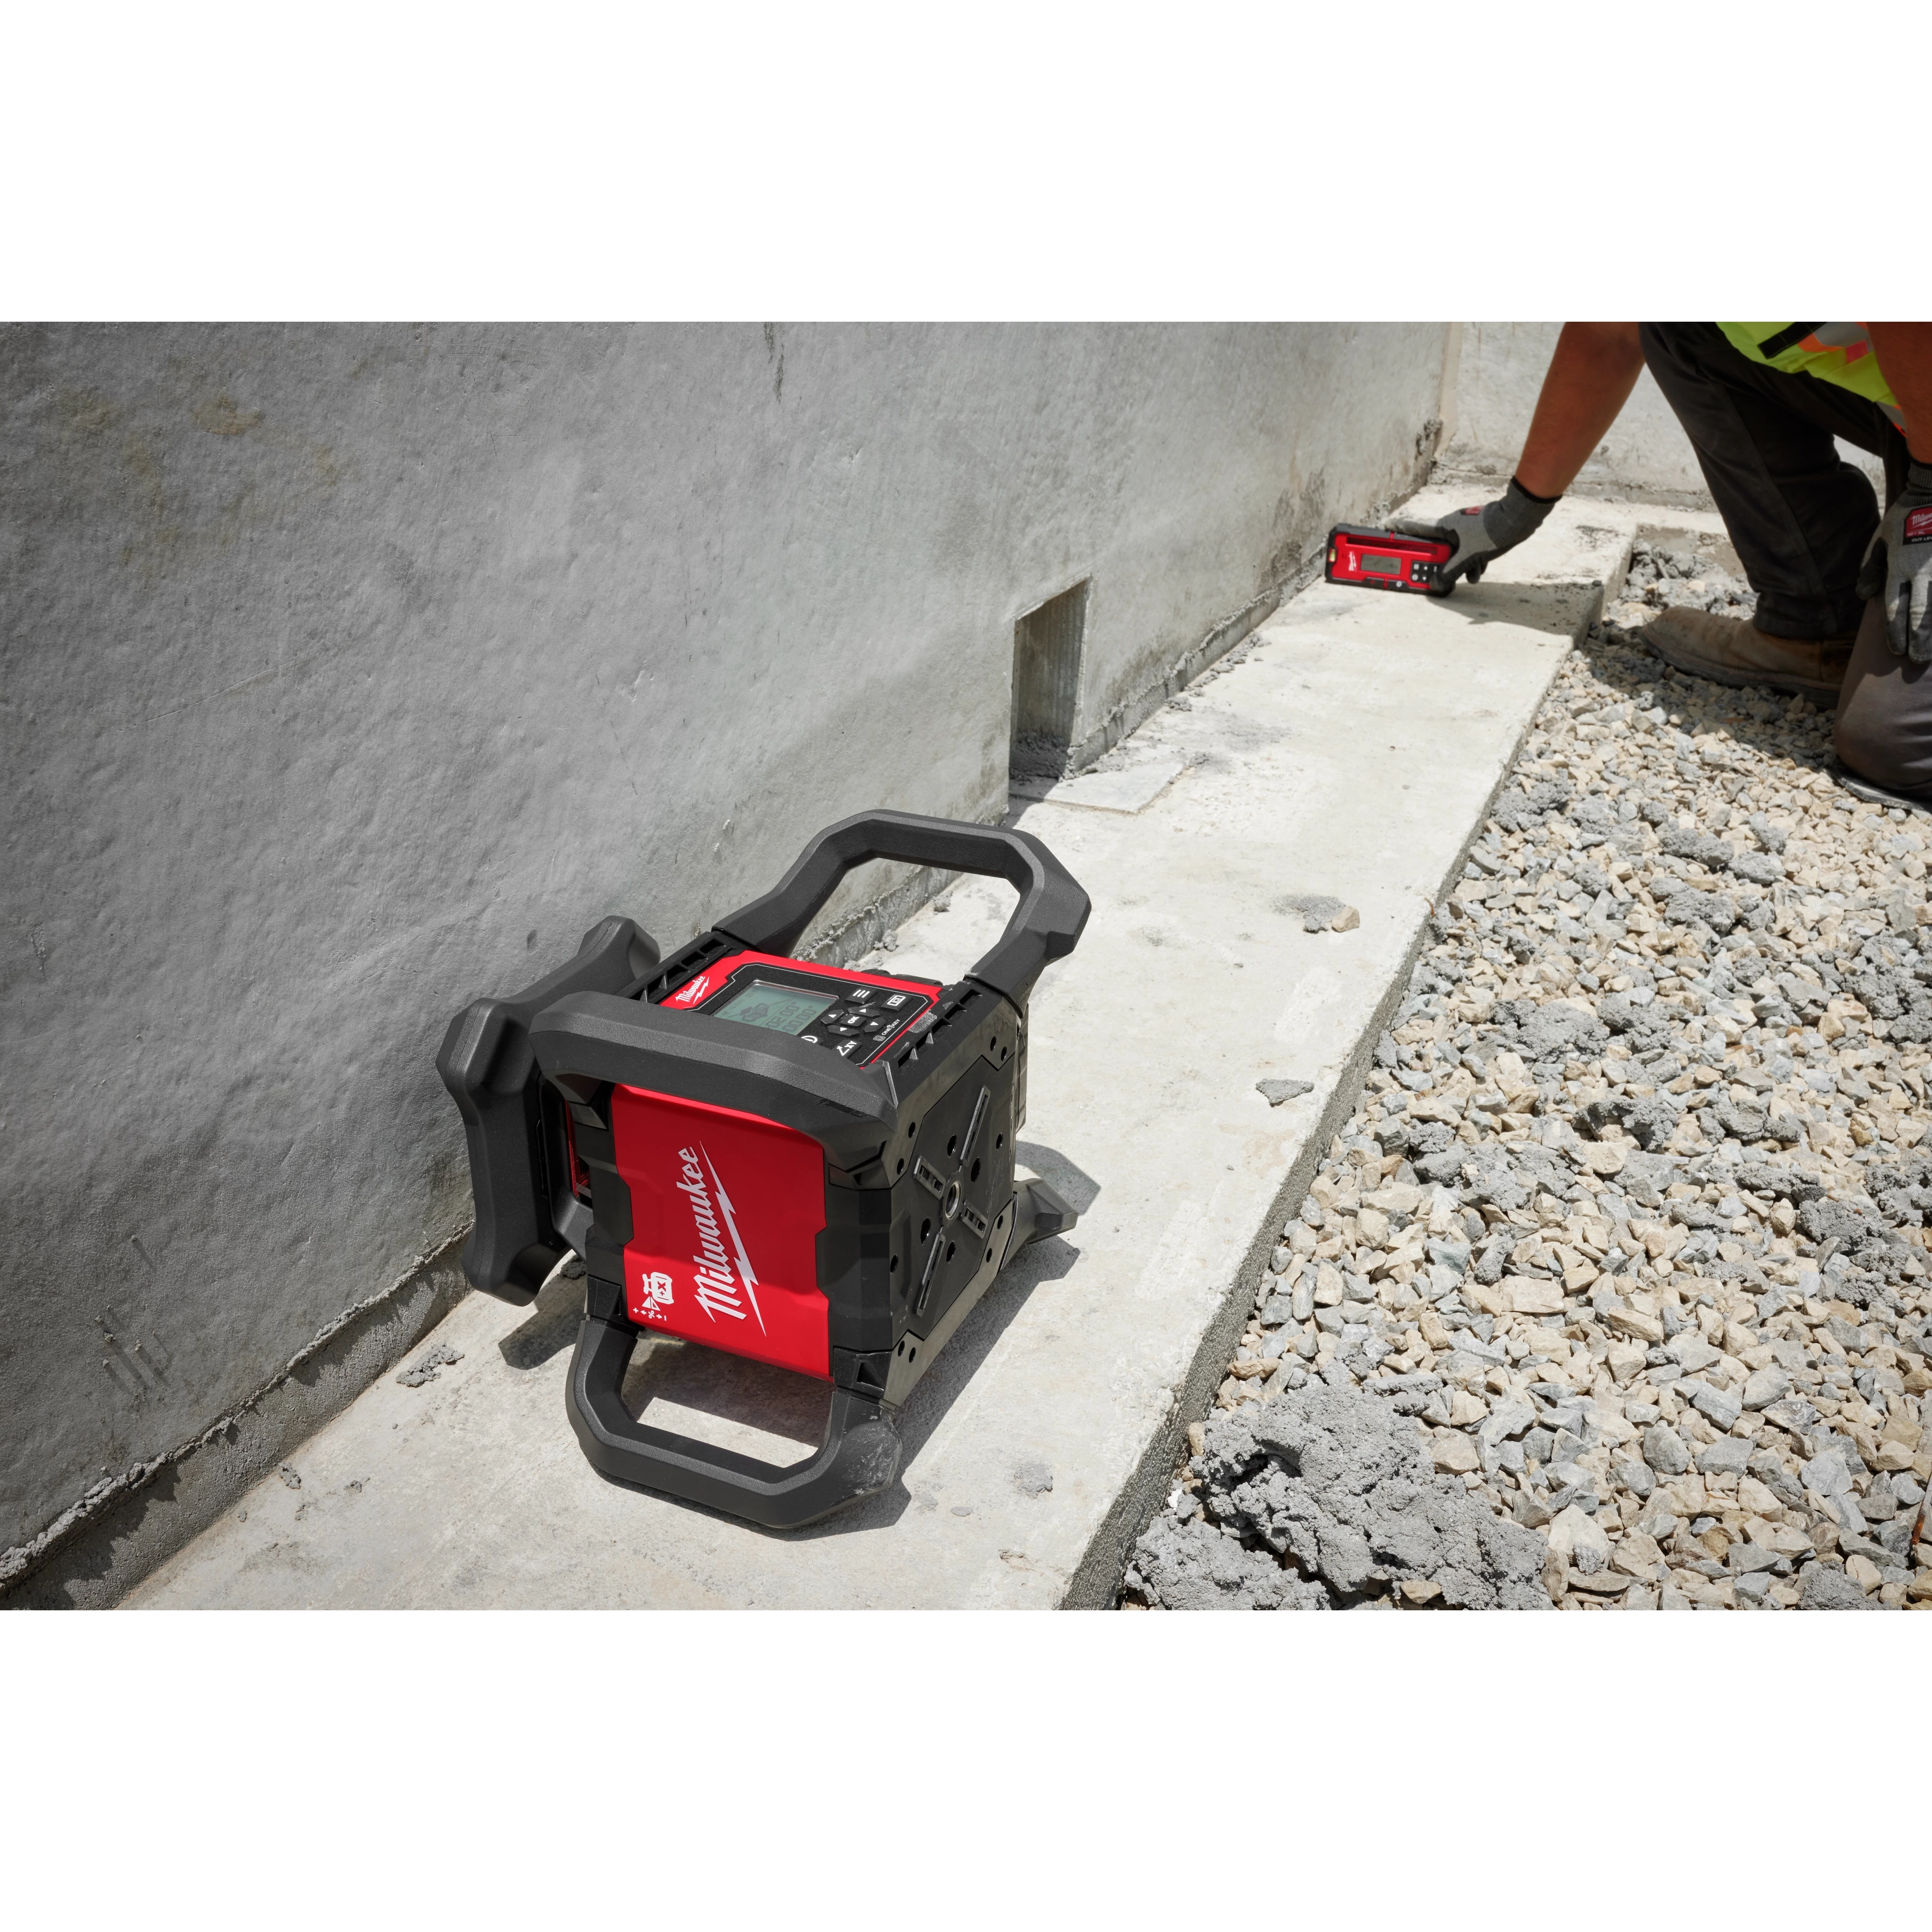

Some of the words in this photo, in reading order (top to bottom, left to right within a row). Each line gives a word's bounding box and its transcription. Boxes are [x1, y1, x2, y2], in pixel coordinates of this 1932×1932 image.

[675, 976, 705, 1002] Milwaukee
[844, 1040, 857, 1049] XY
[676, 1147, 747, 1322] Milwaukee
